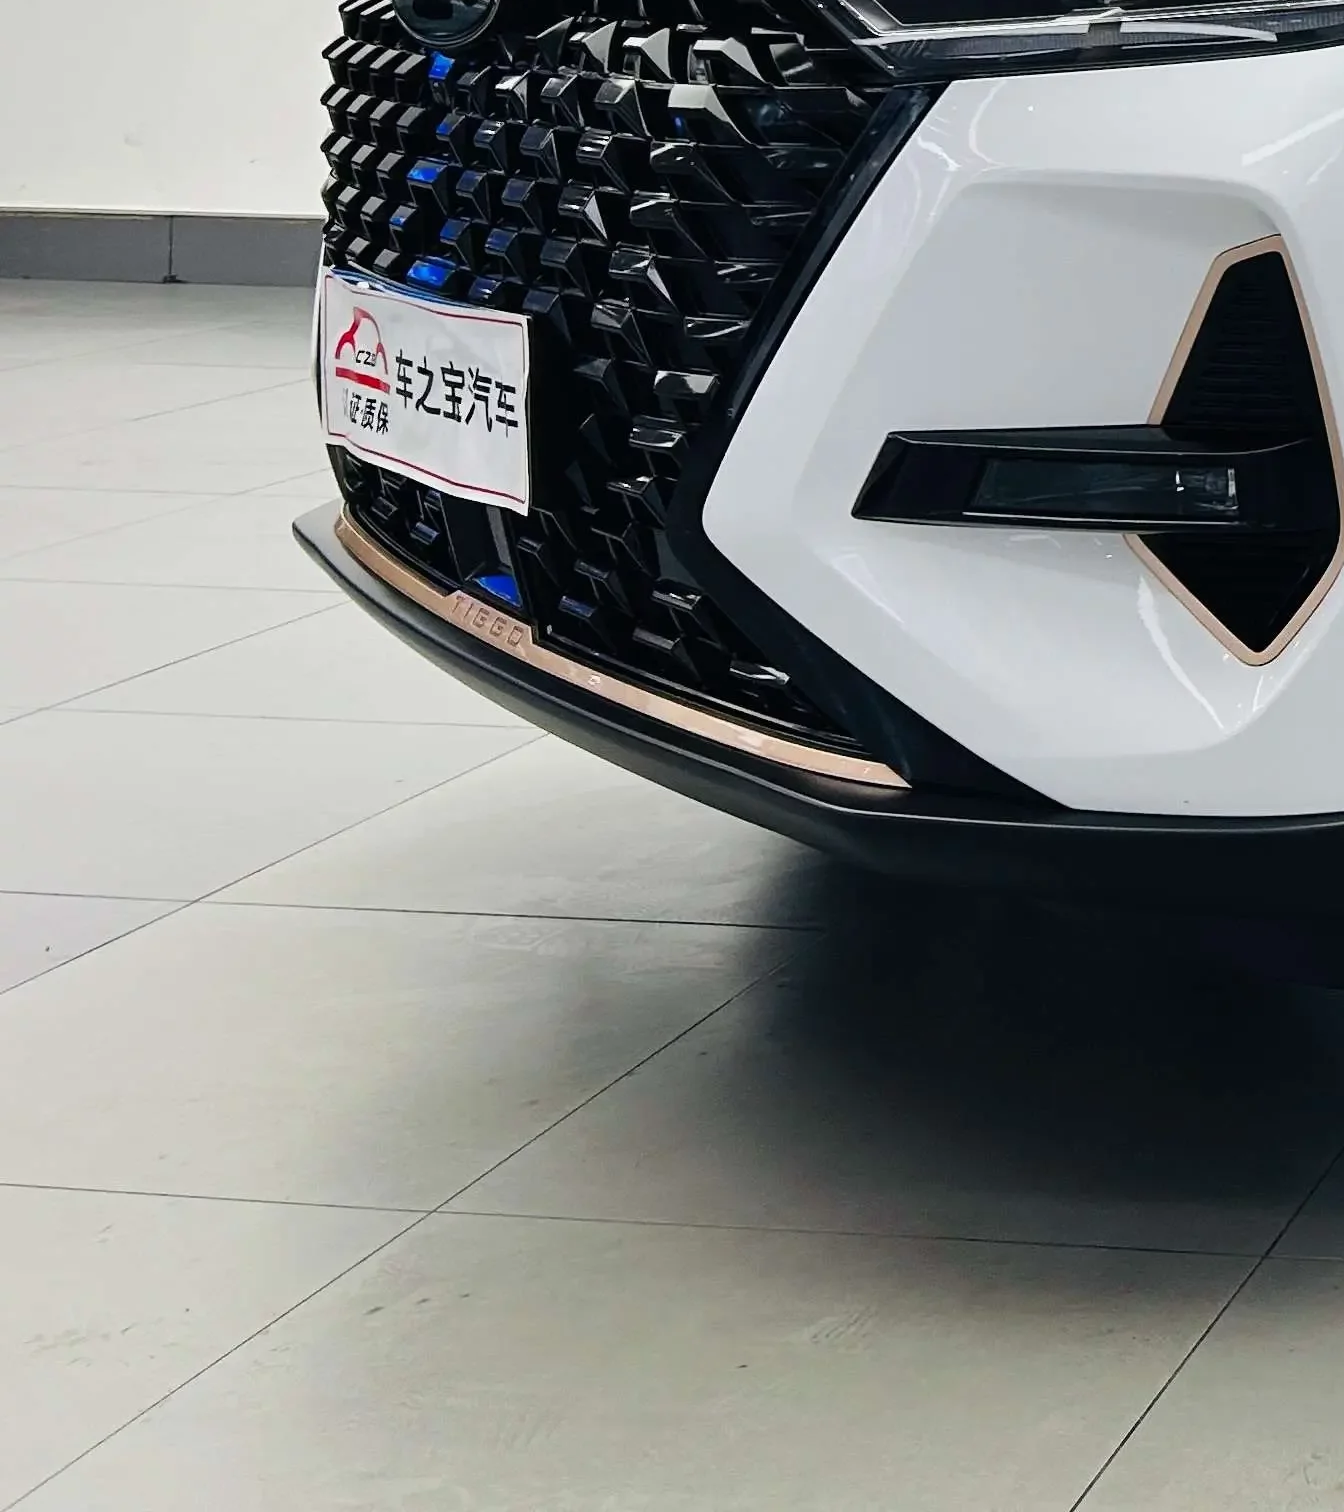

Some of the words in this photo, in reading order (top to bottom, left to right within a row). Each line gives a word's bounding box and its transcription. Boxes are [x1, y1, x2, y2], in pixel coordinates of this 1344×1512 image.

[395, 349, 519, 438] 车之宝汽车
[451, 594, 525, 648] TIGGO
